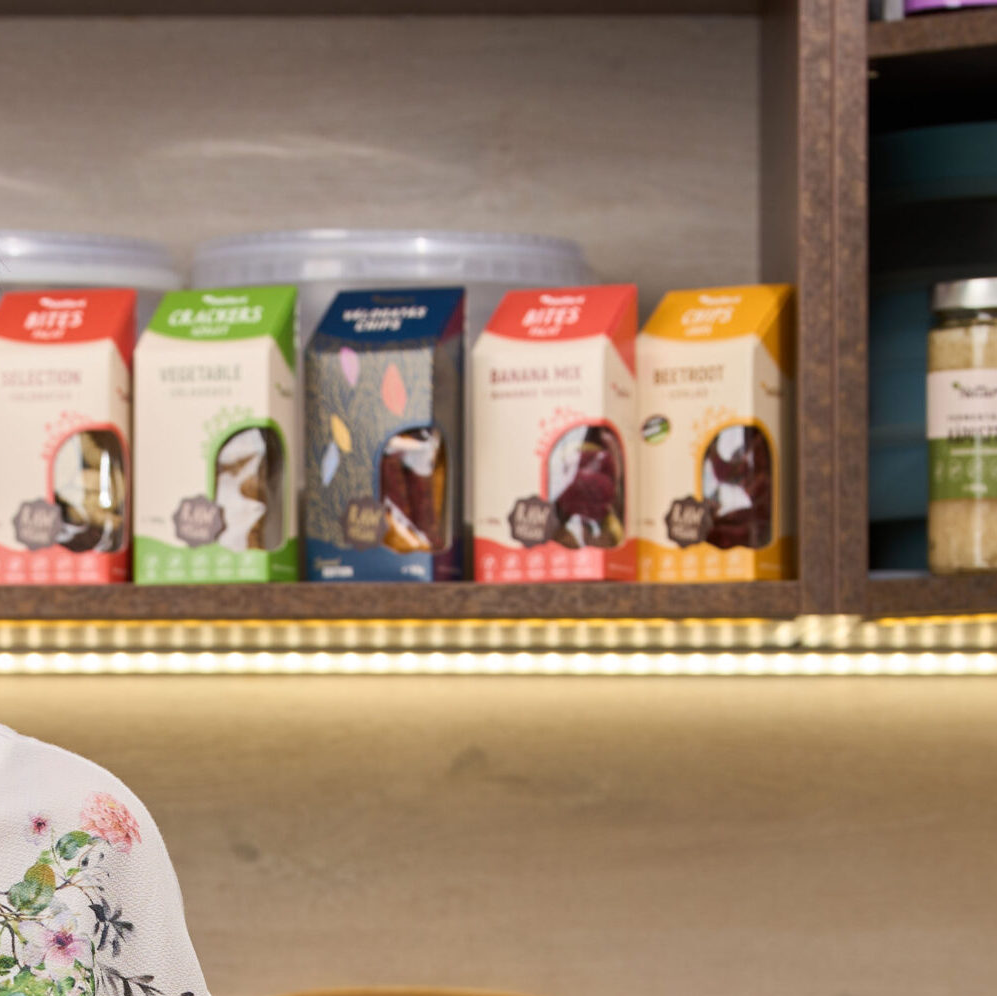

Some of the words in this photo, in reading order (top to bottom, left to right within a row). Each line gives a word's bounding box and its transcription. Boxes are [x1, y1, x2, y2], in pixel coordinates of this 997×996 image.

[24, 310, 84, 331] BITES
[168, 305, 264, 327] CRACKERS
[521, 306, 582, 328] BITES
[1, 368, 82, 386] SELECTION
[159, 364, 241, 382] VEGETABLE
[490, 366, 549, 384] BANANA
[553, 364, 581, 381] MIX
[653, 364, 724, 385] BEETROOT
